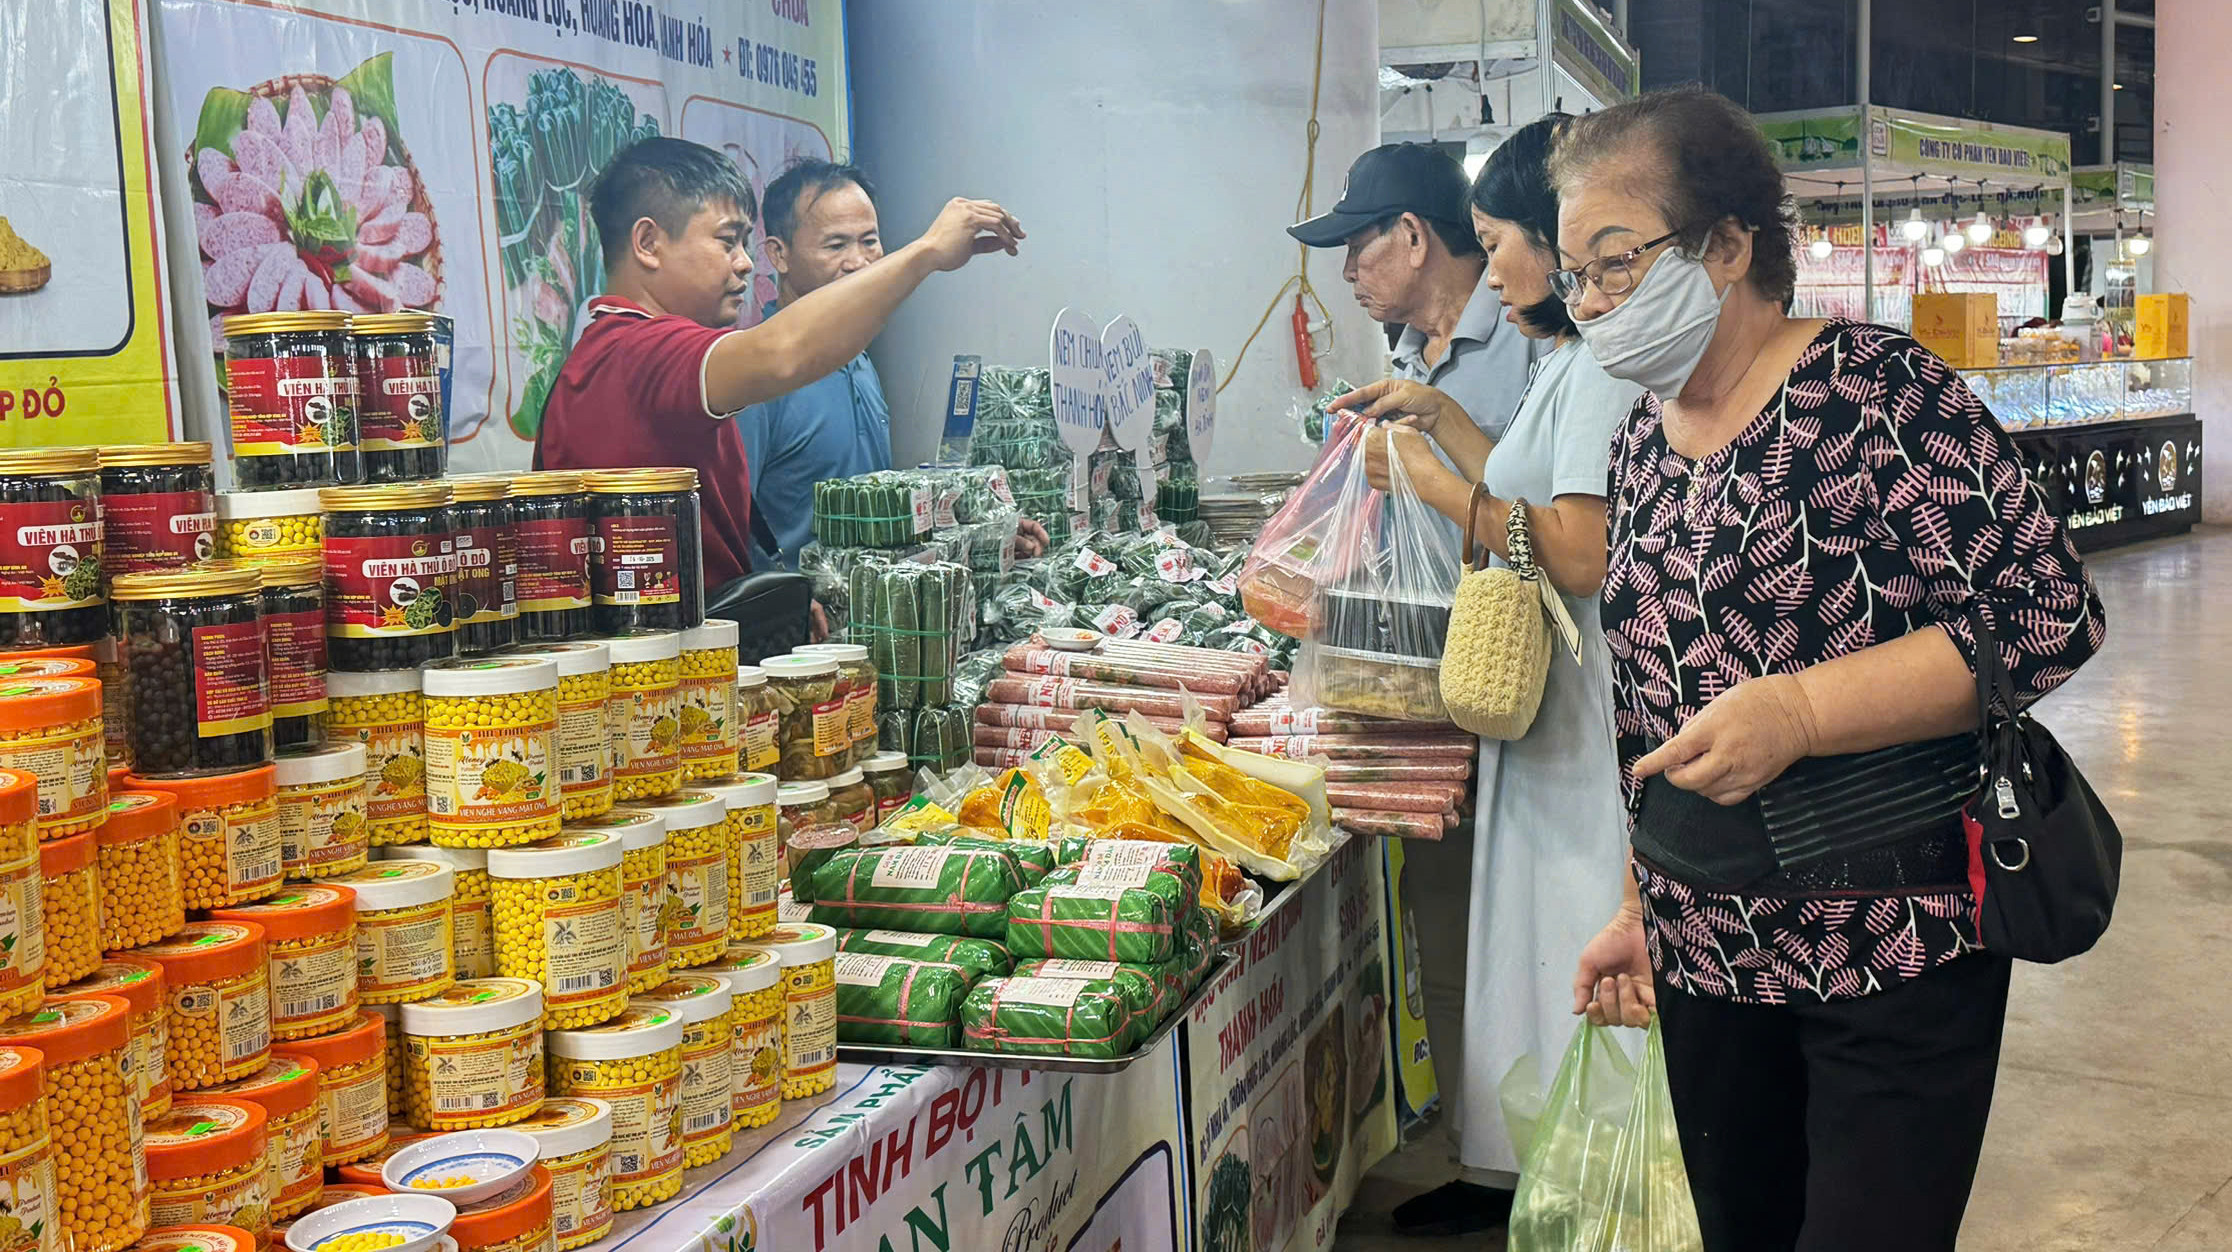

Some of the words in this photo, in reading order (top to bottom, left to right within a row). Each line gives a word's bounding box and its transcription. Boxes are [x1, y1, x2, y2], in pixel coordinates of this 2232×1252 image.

[1056, 328, 1076, 368] NEM
[22, 376, 66, 420] ĐỎ
[283, 380, 312, 396] VIÊN
[175, 517, 199, 533] VIÊN
[24, 527, 54, 546] VIÊN
[59, 526, 77, 544] HÀ
[368, 561, 398, 577] VIÊN
[401, 559, 418, 576] HÀ
[420, 556, 440, 575] THỦ
[459, 551, 468, 566] Ô
[470, 549, 487, 566] ĐỎ
[457, 567, 470, 580] ẬT
[471, 568, 490, 580] ONG
[1218, 997, 1257, 1076] THANH
[1260, 971, 1284, 1033] HÓA
[965, 1075, 1074, 1217] TÂM
[802, 1115, 918, 1252] TINH
